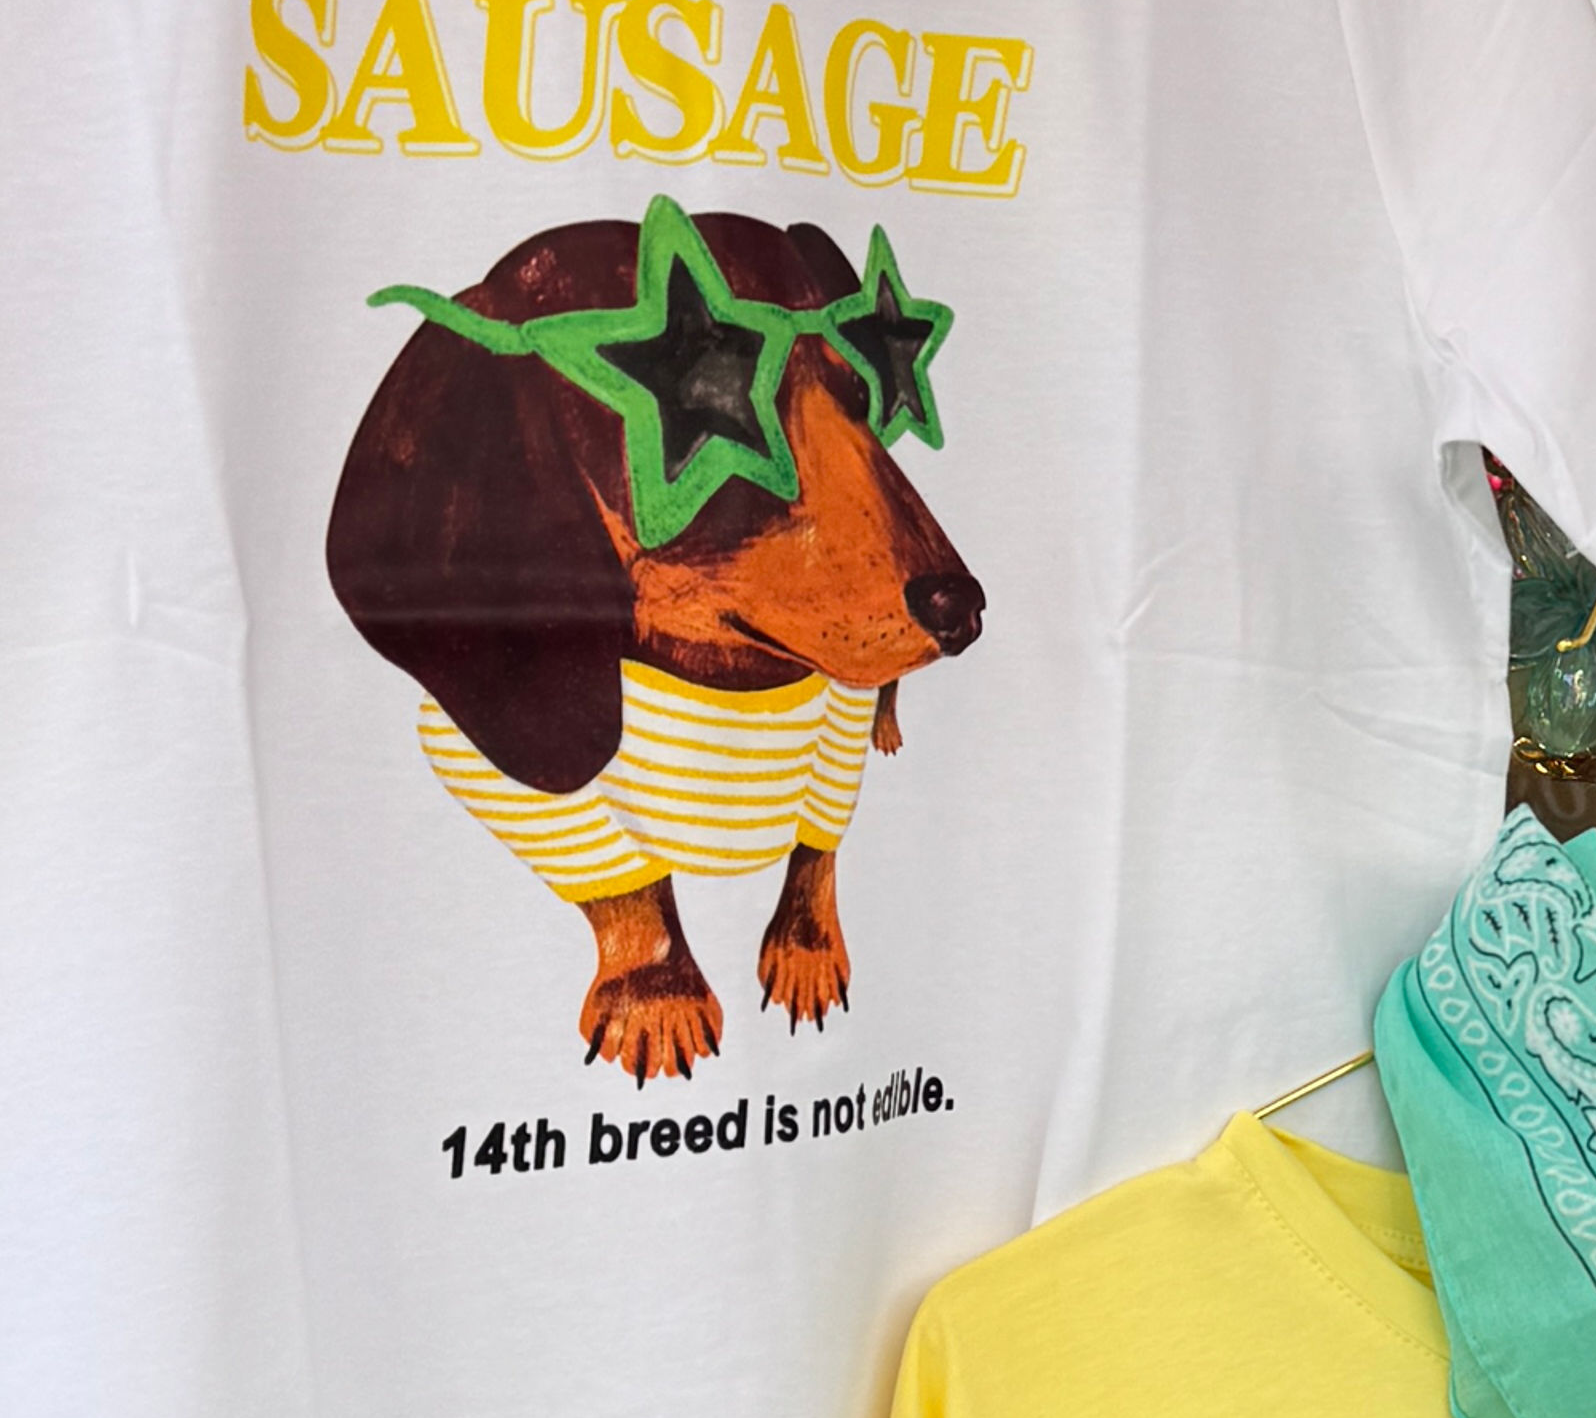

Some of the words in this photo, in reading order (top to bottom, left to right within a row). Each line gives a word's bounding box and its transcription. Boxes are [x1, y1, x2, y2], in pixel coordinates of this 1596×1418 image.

[441, 1116, 567, 1179] 14th
[588, 1098, 748, 1163] breed
[763, 1094, 800, 1145] is
[811, 1081, 867, 1138] not
[872, 1066, 956, 1126] edible.
